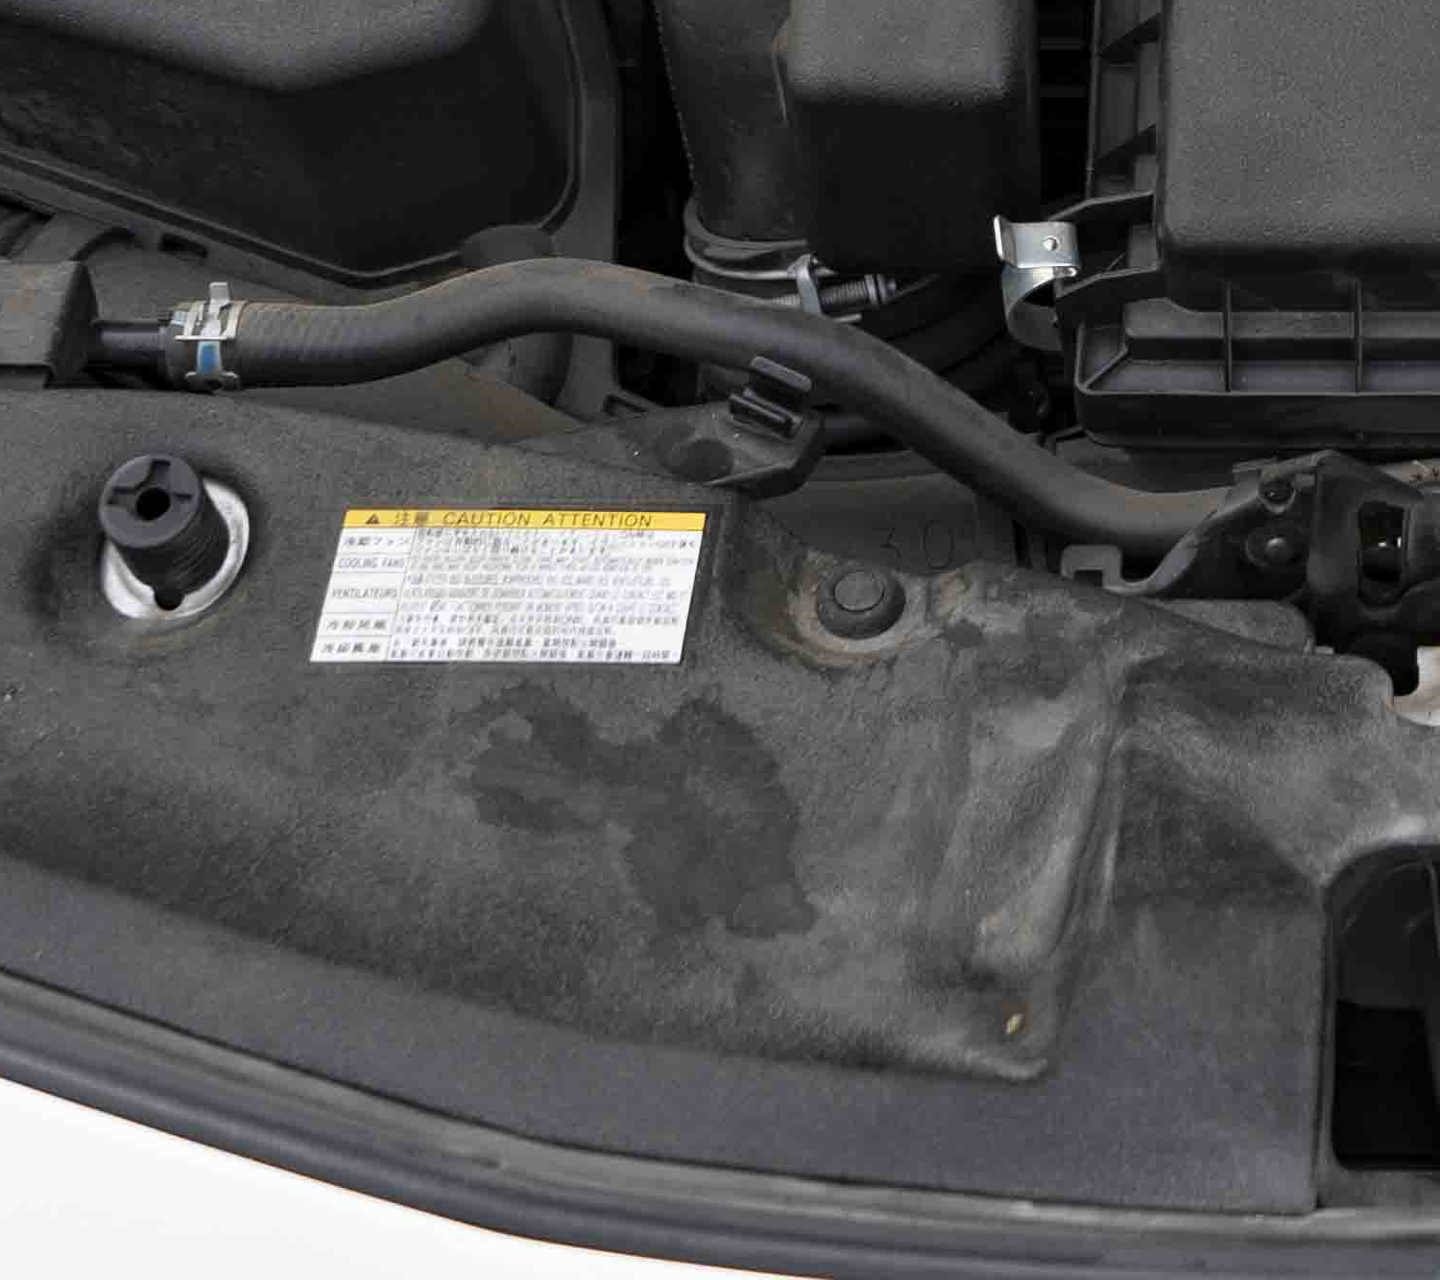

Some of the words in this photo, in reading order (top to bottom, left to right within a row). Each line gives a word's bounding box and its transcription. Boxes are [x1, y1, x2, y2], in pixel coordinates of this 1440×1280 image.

[443, 511, 531, 527] CAUTION
[542, 512, 652, 528] ATTENTION
[337, 557, 379, 569] COOLING
[331, 587, 398, 600] VENTILATEURS
